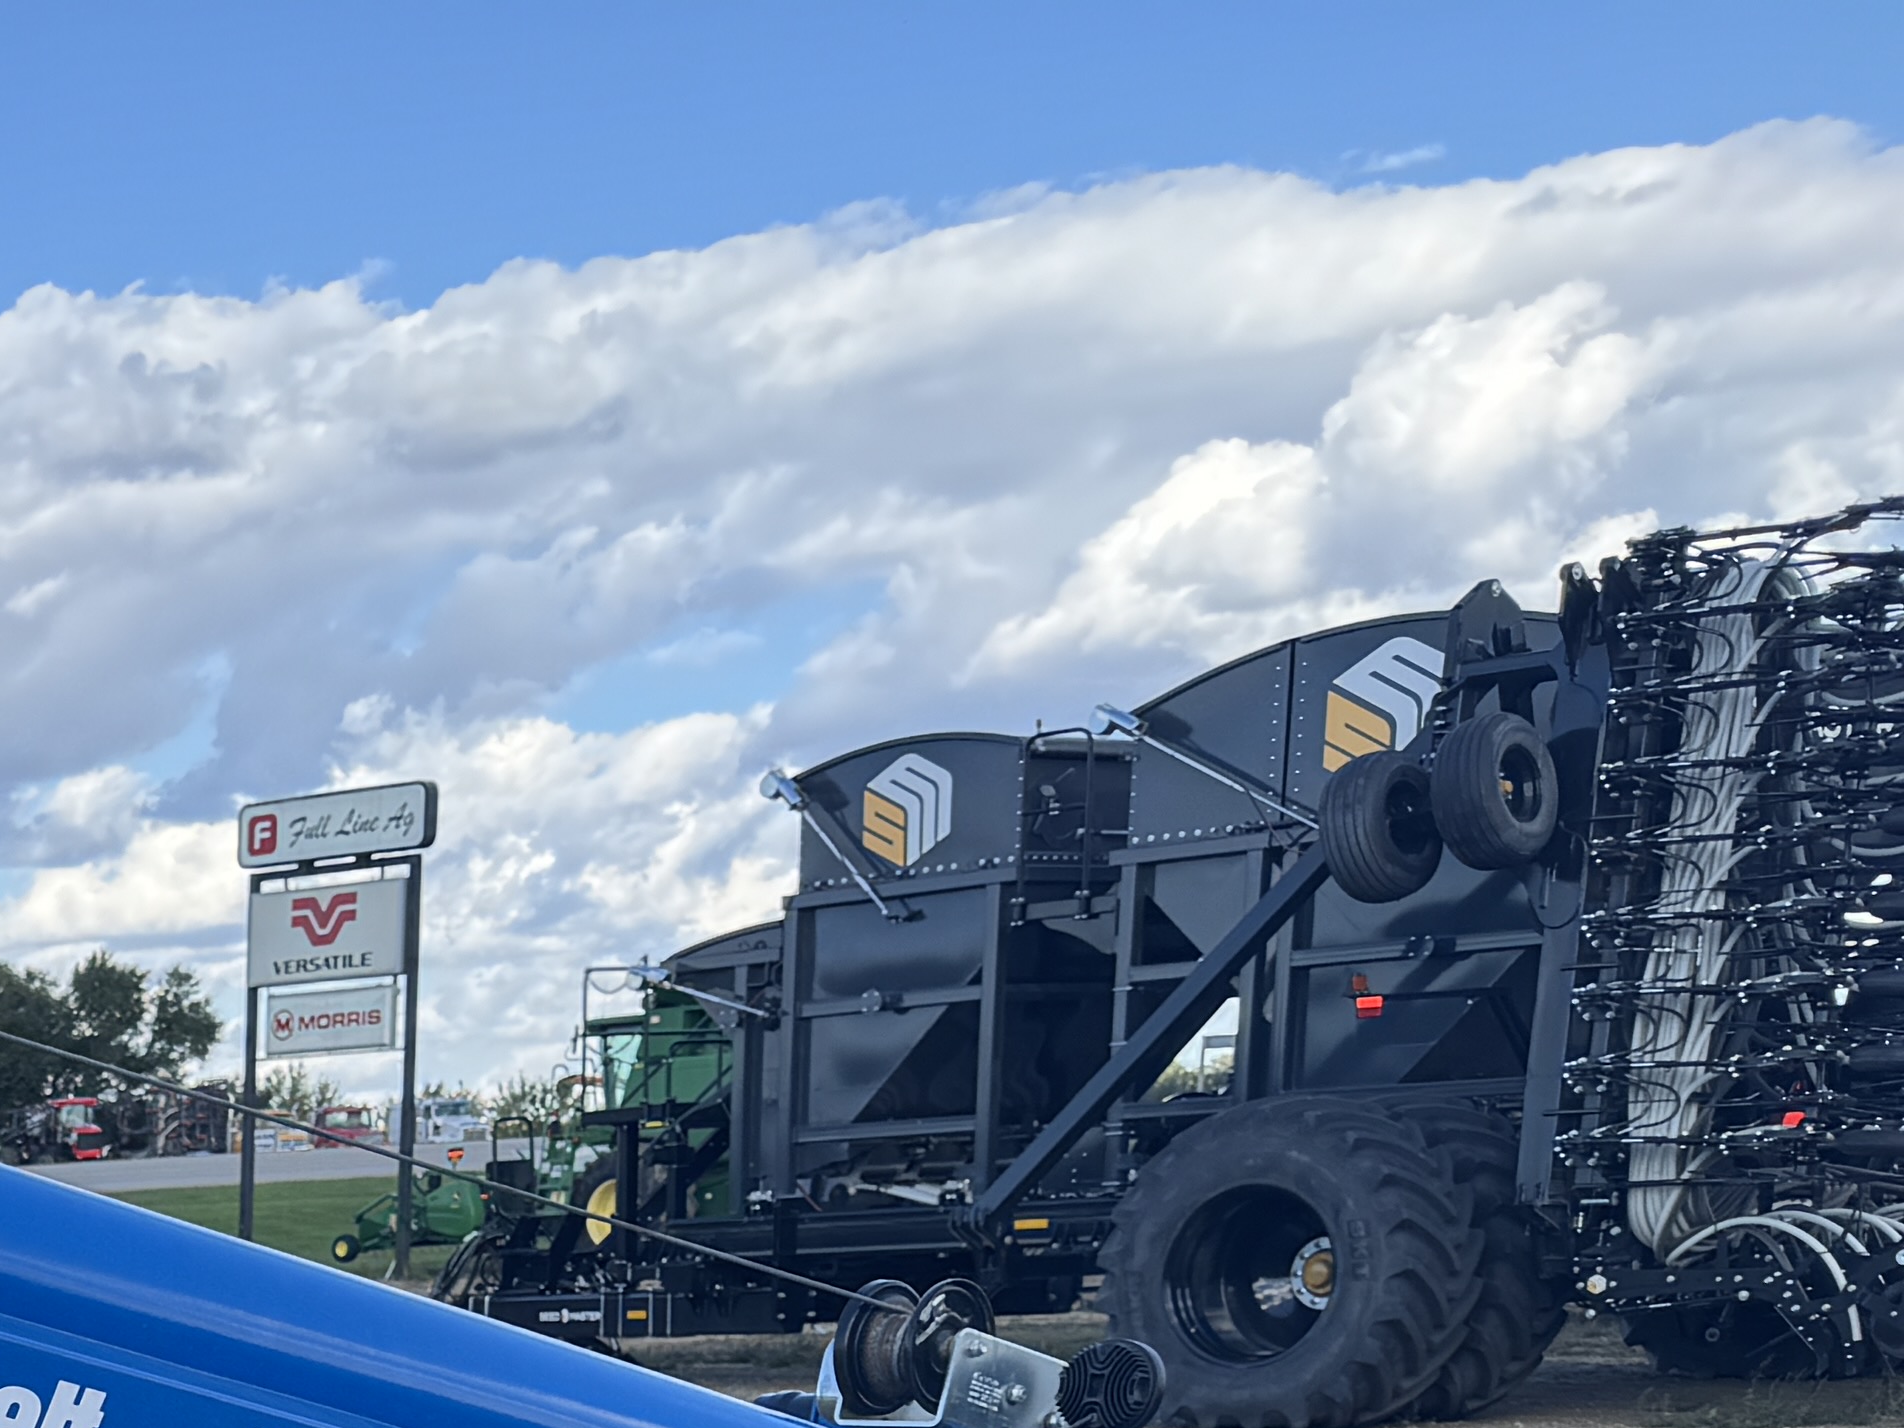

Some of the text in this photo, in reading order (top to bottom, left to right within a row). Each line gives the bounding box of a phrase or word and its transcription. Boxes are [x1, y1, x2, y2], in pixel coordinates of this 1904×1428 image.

[289, 815, 331, 848] Full
[334, 808, 379, 836] Line
[382, 802, 415, 837] Ag
[273, 952, 373, 975] VERSATILE
[298, 1009, 382, 1032] MORRIS
